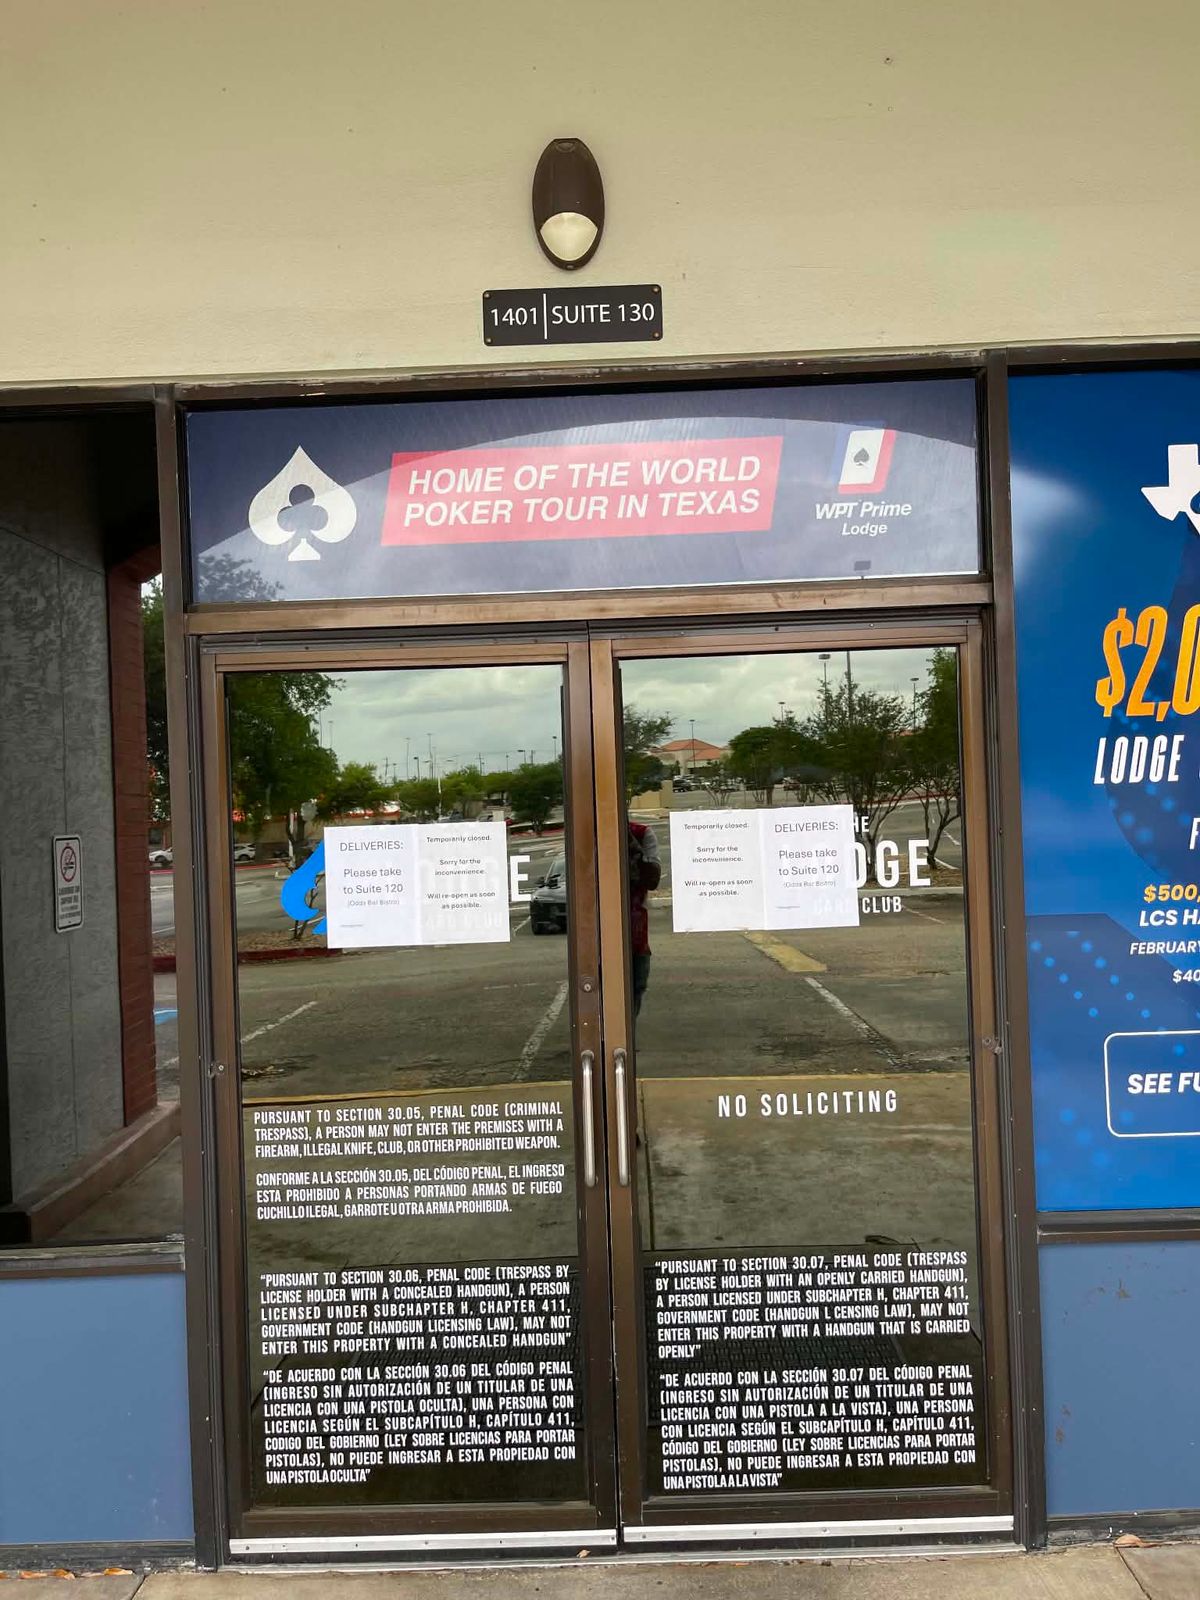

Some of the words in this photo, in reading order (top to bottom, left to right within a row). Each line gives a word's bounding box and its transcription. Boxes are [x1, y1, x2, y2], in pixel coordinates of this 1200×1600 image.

[490, 307, 537, 326] 1401
[551, 304, 611, 325] SUITE
[618, 302, 655, 323] 130
[409, 467, 503, 495] HOME
[514, 465, 557, 490] OF
[568, 462, 629, 488] THE
[642, 456, 759, 485] WORLD
[404, 499, 512, 527] POKER
[524, 495, 607, 522] TOUR
[618, 494, 647, 519] IN
[659, 490, 758, 517] TEXAS
[815, 502, 858, 520] WPT
[860, 501, 912, 518] Prime
[842, 523, 888, 537] Lodge
[1093, 734, 1185, 785] LODGE
[684, 822, 724, 831] Temporarily
[725, 821, 750, 830] closed.
[774, 821, 838, 833] DELIVERIES:
[340, 840, 403, 851] DELIVERIES:
[697, 846, 715, 854] Sorry
[716, 845, 726, 854] for
[727, 845, 738, 853] the
[779, 848, 813, 859] Please
[815, 848, 837, 858] take
[459, 858, 468, 866] for
[778, 866, 789, 876] to
[791, 865, 817, 876] Suite
[821, 865, 839, 875] 120
[344, 868, 377, 878] Please
[380, 867, 402, 877] take
[343, 885, 354, 894] to
[356, 884, 382, 894] Suite
[385, 884, 404, 893] 120
[699, 879, 727, 887] re-open
[427, 892, 441, 900] Will
[441, 892, 469, 900] re-open
[470, 891, 478, 899] as
[479, 891, 496, 899] soon
[709, 889, 739, 897] possible.
[442, 902, 450, 910] as
[451, 901, 482, 910] possible.
[862, 896, 902, 914] CLUB
[1139, 909, 1178, 927] LCS
[1127, 1073, 1172, 1094] SEE
[719, 1094, 746, 1117] NO
[761, 1090, 897, 1116] SOLICITING
[254, 1110, 311, 1124] PURSUANT
[317, 1109, 330, 1122] TO
[336, 1108, 382, 1122] SECTION
[388, 1106, 424, 1120] 30.05,
[430, 1105, 465, 1119] PENAL
[471, 1104, 499, 1117] CODE
[505, 1102, 563, 1116] (CRIMINAL
[255, 1127, 312, 1141] TRESPASS),
[316, 1127, 323, 1139] A
[326, 1125, 365, 1139] PERSON
[368, 1124, 389, 1137] MAY
[393, 1124, 413, 1137] NOT
[417, 1123, 448, 1136] ENTER
[452, 1122, 471, 1135] THE
[475, 1120, 524, 1134] PREMISES
[527, 1119, 553, 1132] WITH
[557, 1119, 563, 1131] A
[255, 1144, 302, 1158] FIREARM,
[304, 1142, 343, 1156] ILLEGAL
[344, 1141, 376, 1155] KNIFE,
[378, 1141, 406, 1154] CLUB,
[407, 1140, 421, 1153] OR
[422, 1139, 454, 1153] OTHER
[456, 1137, 514, 1152] PROHIBITED
[515, 1136, 560, 1150] WEAPON.
[256, 1172, 310, 1186] CONFORME
[312, 1172, 319, 1184] A
[320, 1171, 333, 1184] LA
[335, 1168, 376, 1184] SECCIÓN
[378, 1169, 411, 1182] 30.05,
[413, 1168, 432, 1181] DEL
[434, 1165, 470, 1181] CÓDIGO
[472, 1166, 507, 1180] PENAL,
[509, 1166, 521, 1178] EL
[522, 1164, 565, 1178] INGRESO
[655, 1260, 718, 1274] “PURSUANT
[723, 1259, 736, 1272] TO
[742, 1258, 787, 1271] SECTION
[793, 1256, 828, 1270] 30.07,
[834, 1255, 869, 1269] PENAL
[874, 1254, 902, 1267] CODE
[907, 1252, 967, 1266] (TRESPASS
[261, 1273, 319, 1287] “PURSUANT
[323, 1273, 337, 1285] TO
[342, 1271, 384, 1285] SECTION
[389, 1270, 422, 1283] 30.06,
[427, 1269, 460, 1282] PENAL
[464, 1268, 491, 1281] CODE
[496, 1266, 551, 1280] (TRESPASS
[556, 1265, 569, 1278] BY
[261, 1290, 302, 1304] LICENSE
[307, 1289, 346, 1302] HOLDER
[351, 1288, 377, 1301] WITH
[382, 1287, 389, 1300] A
[394, 1286, 452, 1300] CONCEALED
[457, 1284, 513, 1298] HANDGUN),
[518, 1284, 526, 1296] A
[530, 1282, 570, 1296] PERSON
[263, 1370, 283, 1384] “DE
[288, 1369, 336, 1383] ACUERDO
[341, 1368, 362, 1381] CON
[367, 1367, 380, 1380] LA
[385, 1364, 430, 1380] SECCIÓN
[435, 1364, 466, 1378] 30.06
[471, 1364, 491, 1377] DEL
[496, 1360, 534, 1376] CÓDIGO
[540, 1361, 573, 1375] PENAL
[660, 1373, 679, 1387] “DE
[684, 1372, 732, 1386] ACUERDO
[737, 1371, 759, 1384] CON
[764, 1371, 777, 1384] LA
[782, 1367, 827, 1383] SECCIÓN
[832, 1368, 864, 1382] 30.07
[869, 1368, 889, 1381] DEL
[894, 1364, 933, 1380] CÓDIGO
[938, 1365, 972, 1379] PENAL
[266, 1470, 287, 1484] UNA
[288, 1469, 329, 1483] PISTOLA
[330, 1468, 371, 1482] OCULTA”
